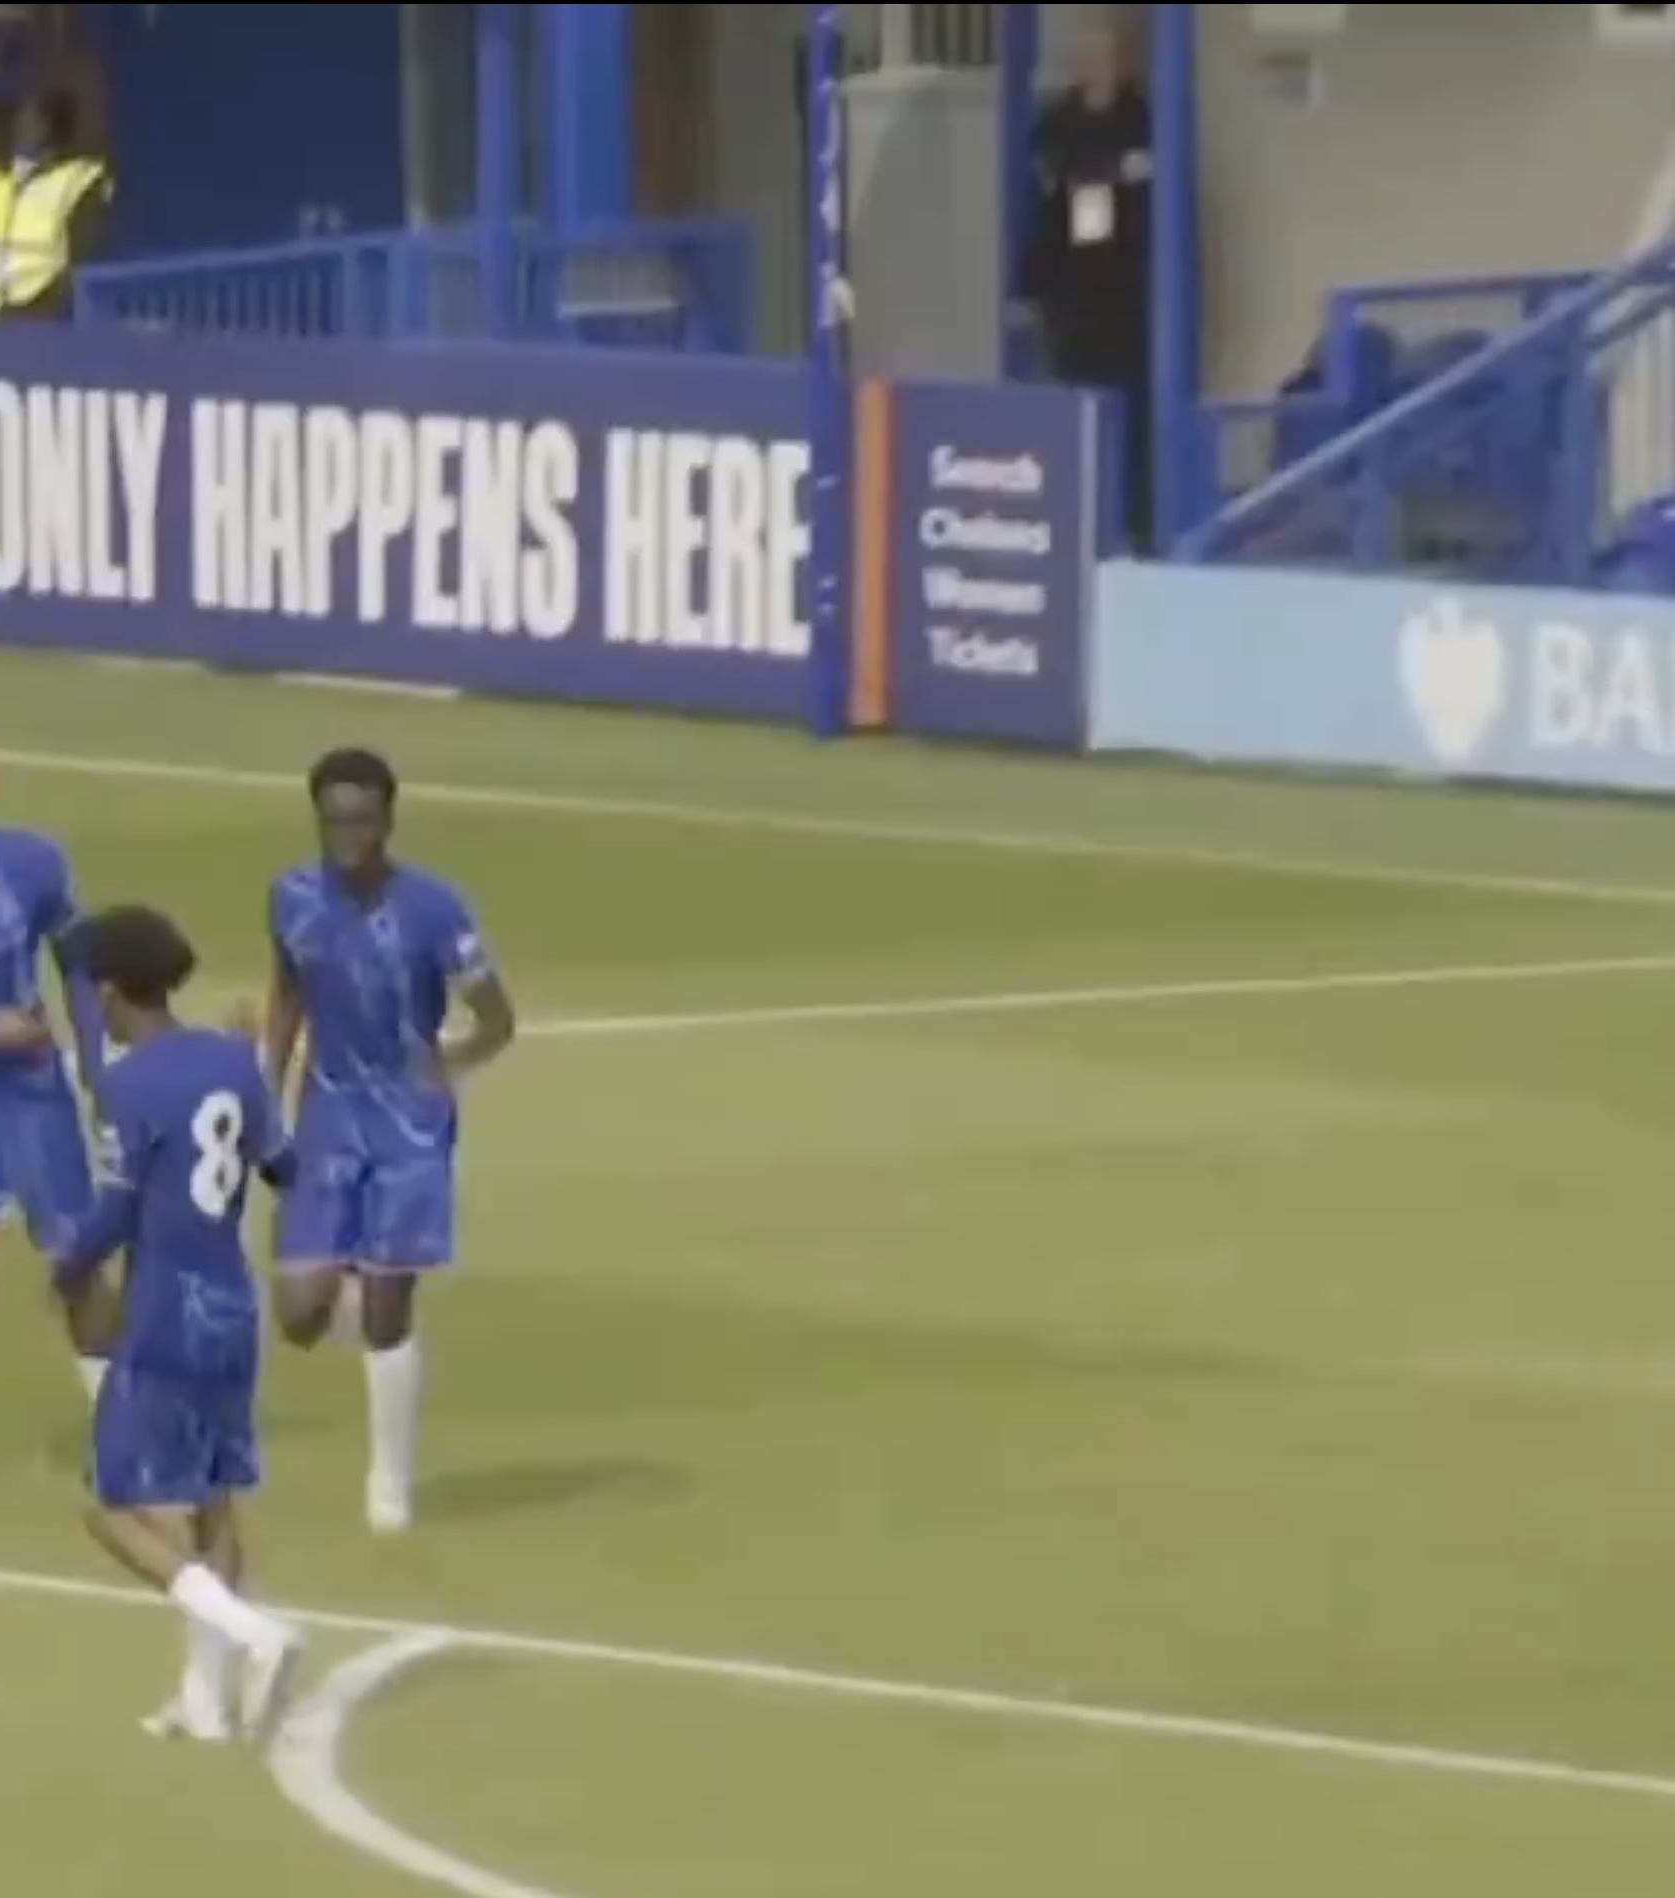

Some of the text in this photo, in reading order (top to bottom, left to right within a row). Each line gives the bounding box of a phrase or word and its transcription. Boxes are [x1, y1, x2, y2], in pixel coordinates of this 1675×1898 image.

[191, 397, 579, 638] HAPPENS
[602, 426, 811, 657] HERE
[1530, 618, 1675, 756] BA
[189, 1089, 243, 1218] 8
